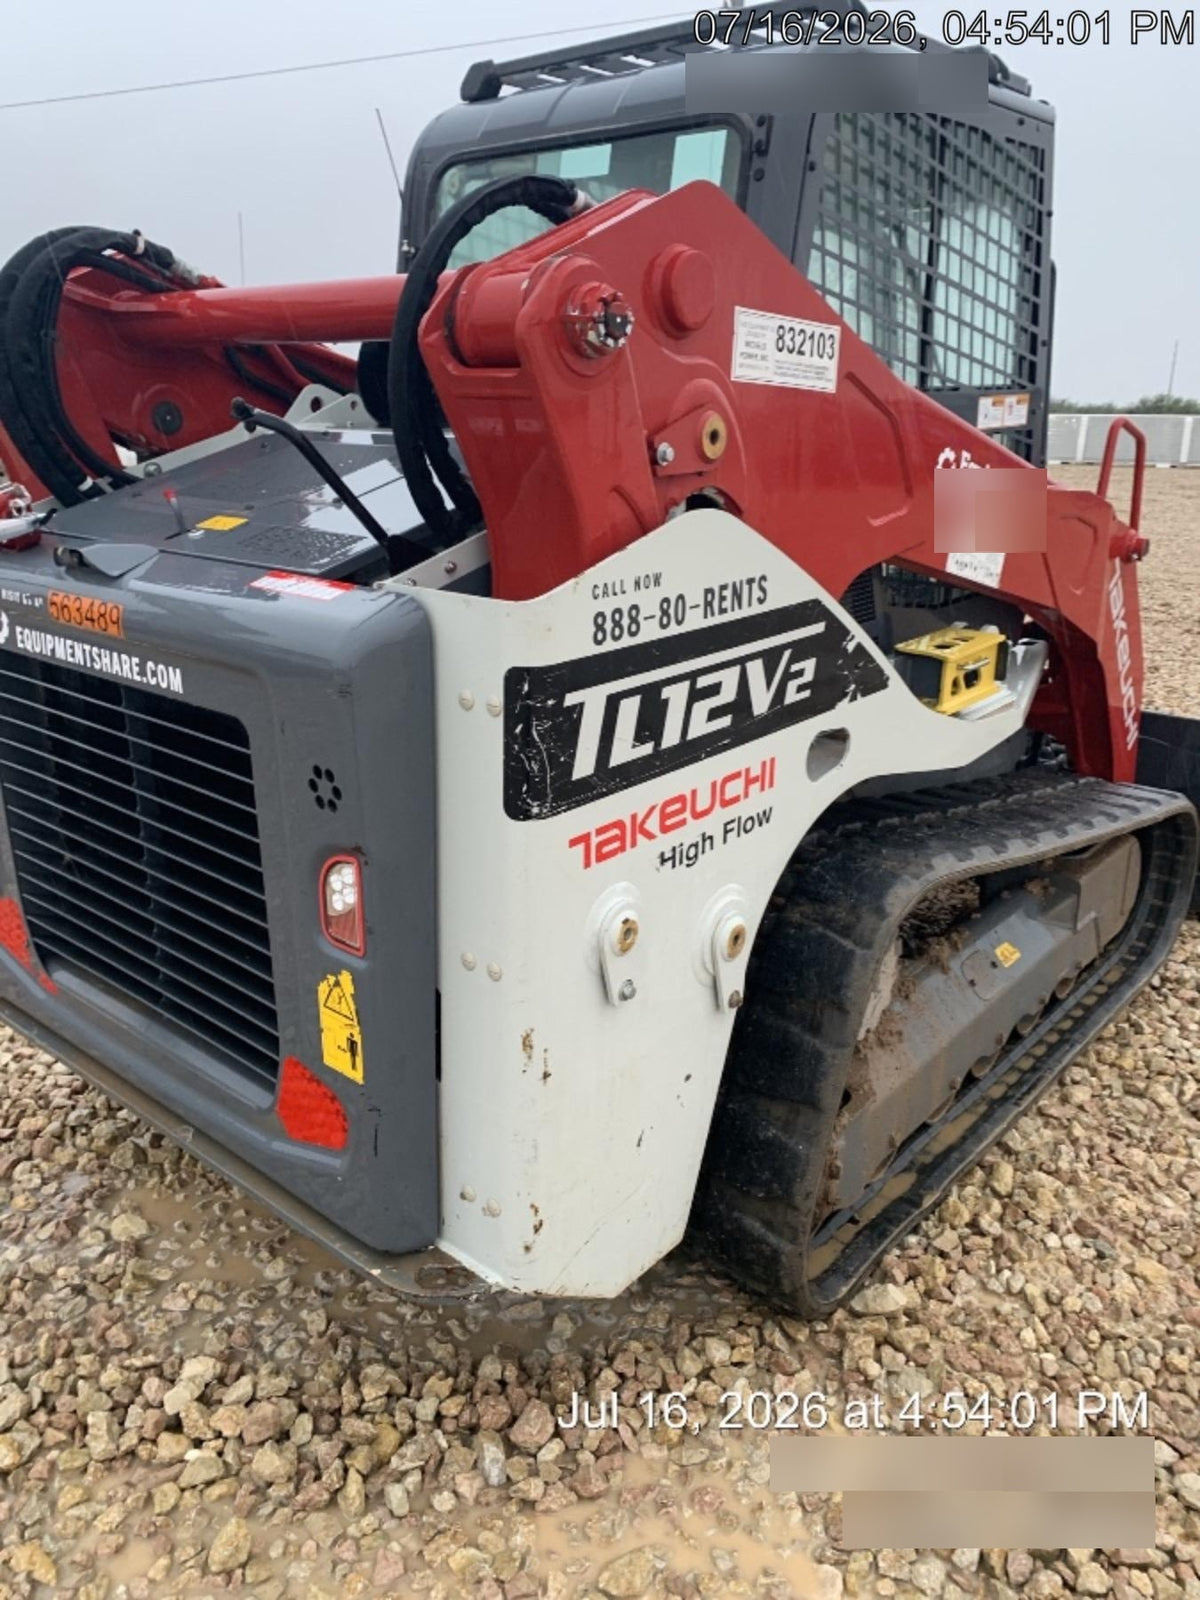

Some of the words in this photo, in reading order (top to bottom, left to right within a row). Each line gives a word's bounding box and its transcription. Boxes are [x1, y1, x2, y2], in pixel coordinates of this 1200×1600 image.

[776, 324, 835, 361] 832103
[49, 592, 121, 635] 563489
[592, 578, 626, 600] CALL
[633, 572, 662, 593] NOW
[592, 574, 768, 646] 888-80-RENTS
[15, 625, 183, 694] EQUIPMENTSHARE.COM
[562, 622, 825, 782] TL12V2
[568, 756, 776, 870] TAKEUCHI
[658, 833, 714, 871] High
[722, 806, 773, 845] Flow
